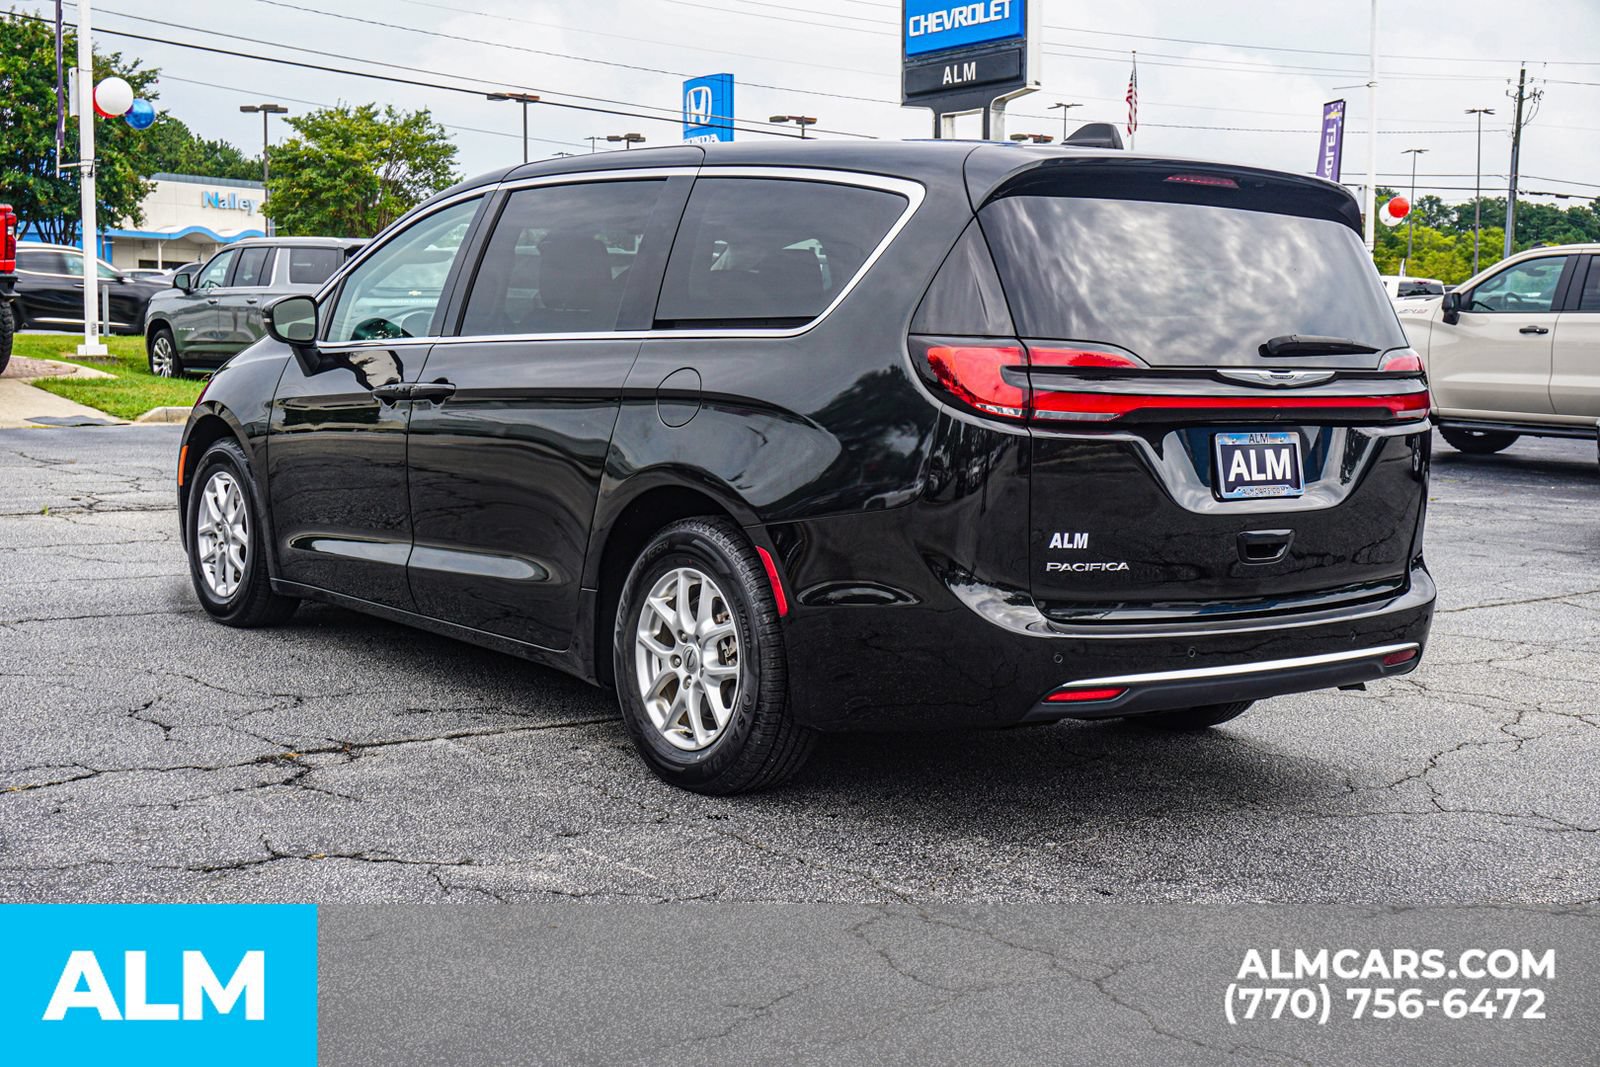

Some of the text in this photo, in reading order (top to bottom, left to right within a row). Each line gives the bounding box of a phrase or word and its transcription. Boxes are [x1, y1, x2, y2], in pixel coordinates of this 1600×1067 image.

[909, 0, 1012, 37] CHEVROLET
[943, 62, 976, 85] ALM
[1248, 434, 1269, 443] ALM
[1228, 448, 1292, 482] ALM
[1049, 532, 1089, 549] ALM
[1046, 562, 1130, 572] PACIFICA
